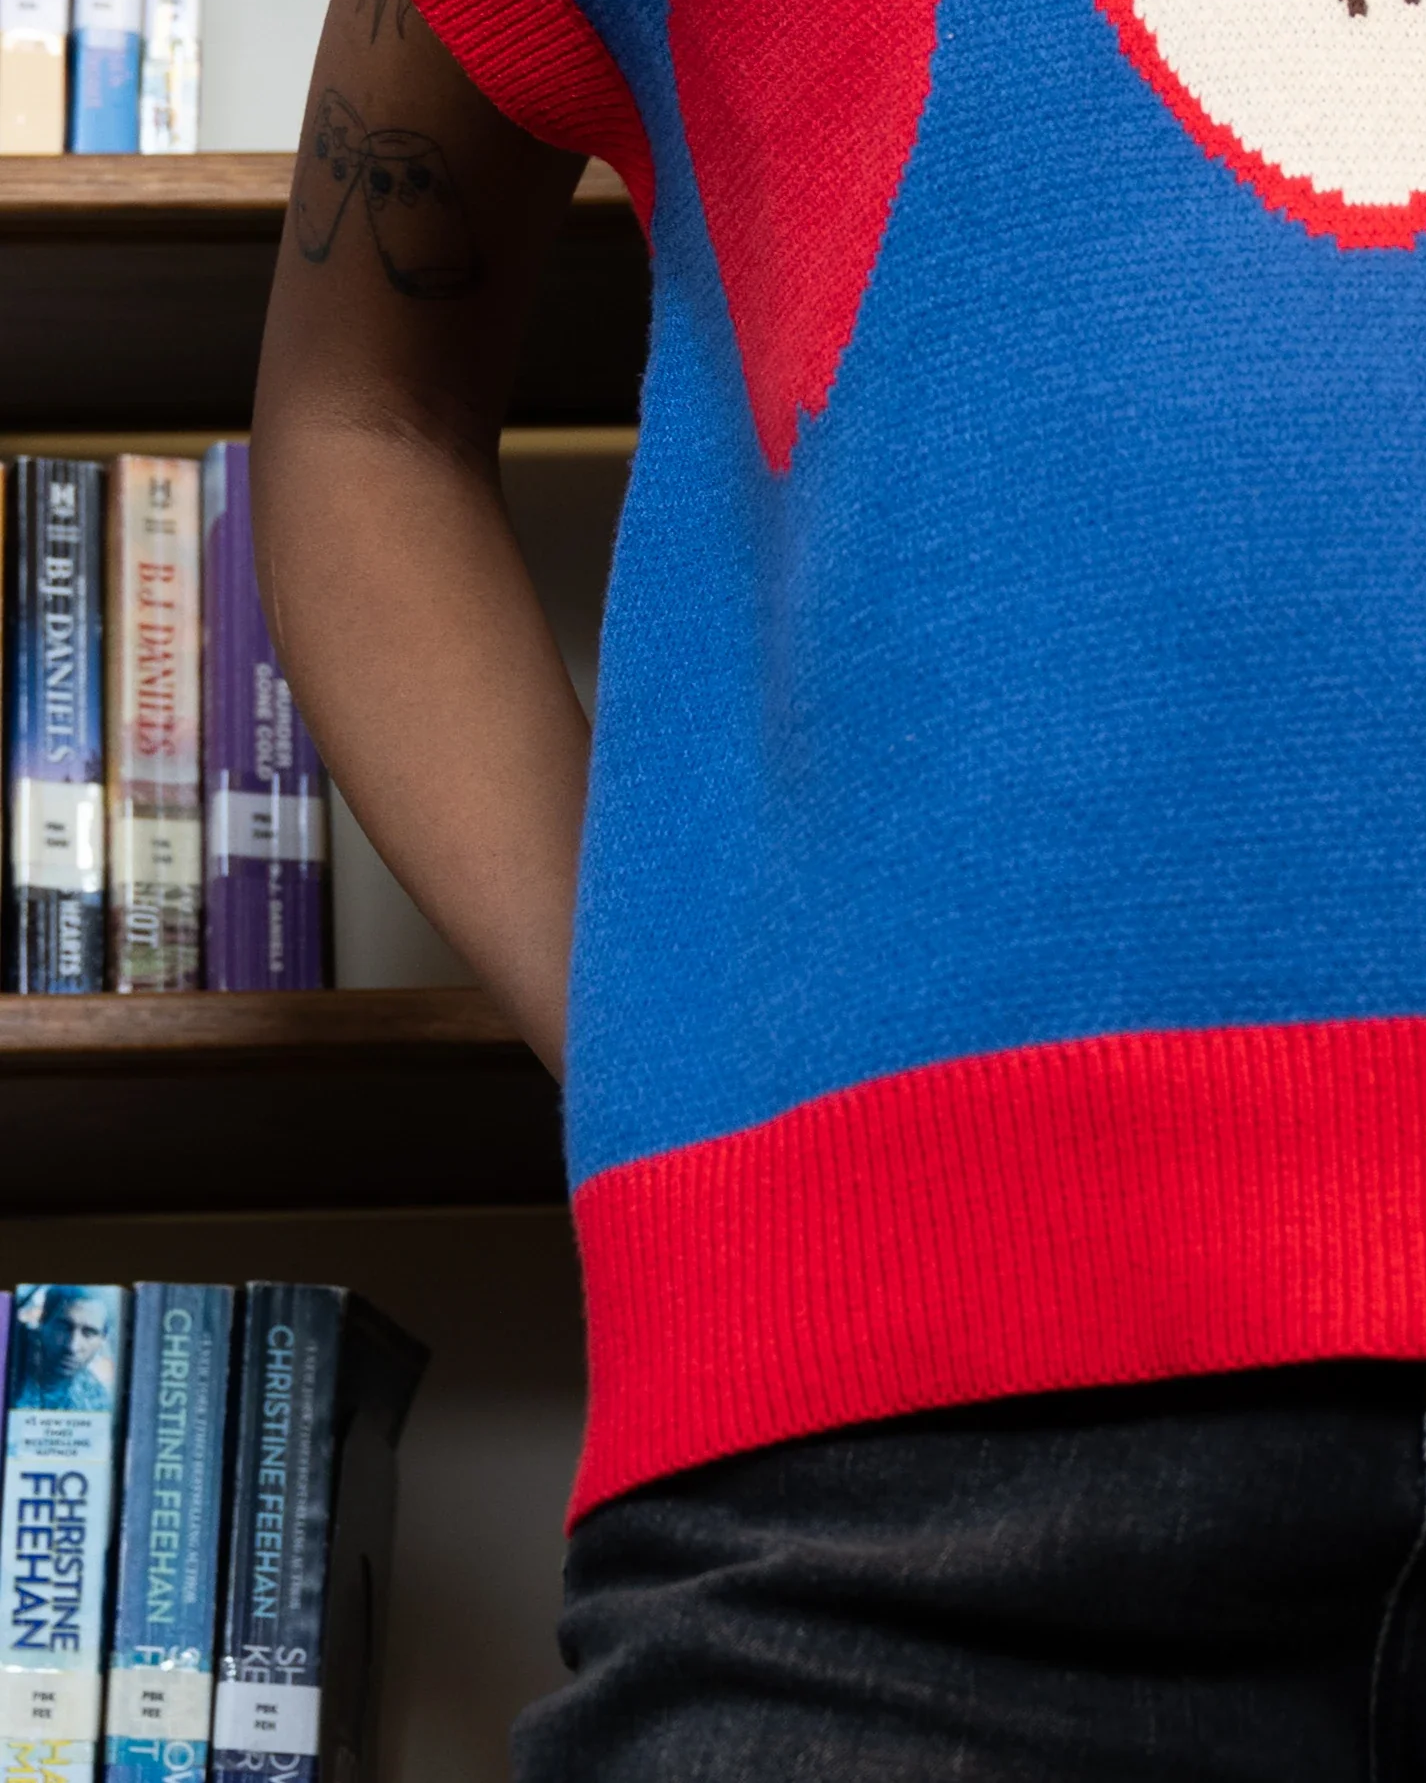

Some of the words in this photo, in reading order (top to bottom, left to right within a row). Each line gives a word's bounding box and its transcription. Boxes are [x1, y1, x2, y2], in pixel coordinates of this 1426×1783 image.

[43, 614, 75, 762] DANIELS
[136, 623, 176, 756] DANIELS
[254, 663, 273, 720] GONE
[255, 726, 274, 780] COLD
[155, 1307, 193, 1482] CHRISTINE
[258, 1324, 295, 1486] CHRISTINE
[11, 1471, 56, 1652] FEEHAN
[49, 1471, 89, 1652] CHRISTINE
[147, 1488, 182, 1624] FEEHAN
[252, 1492, 285, 1620] FEEHAN
